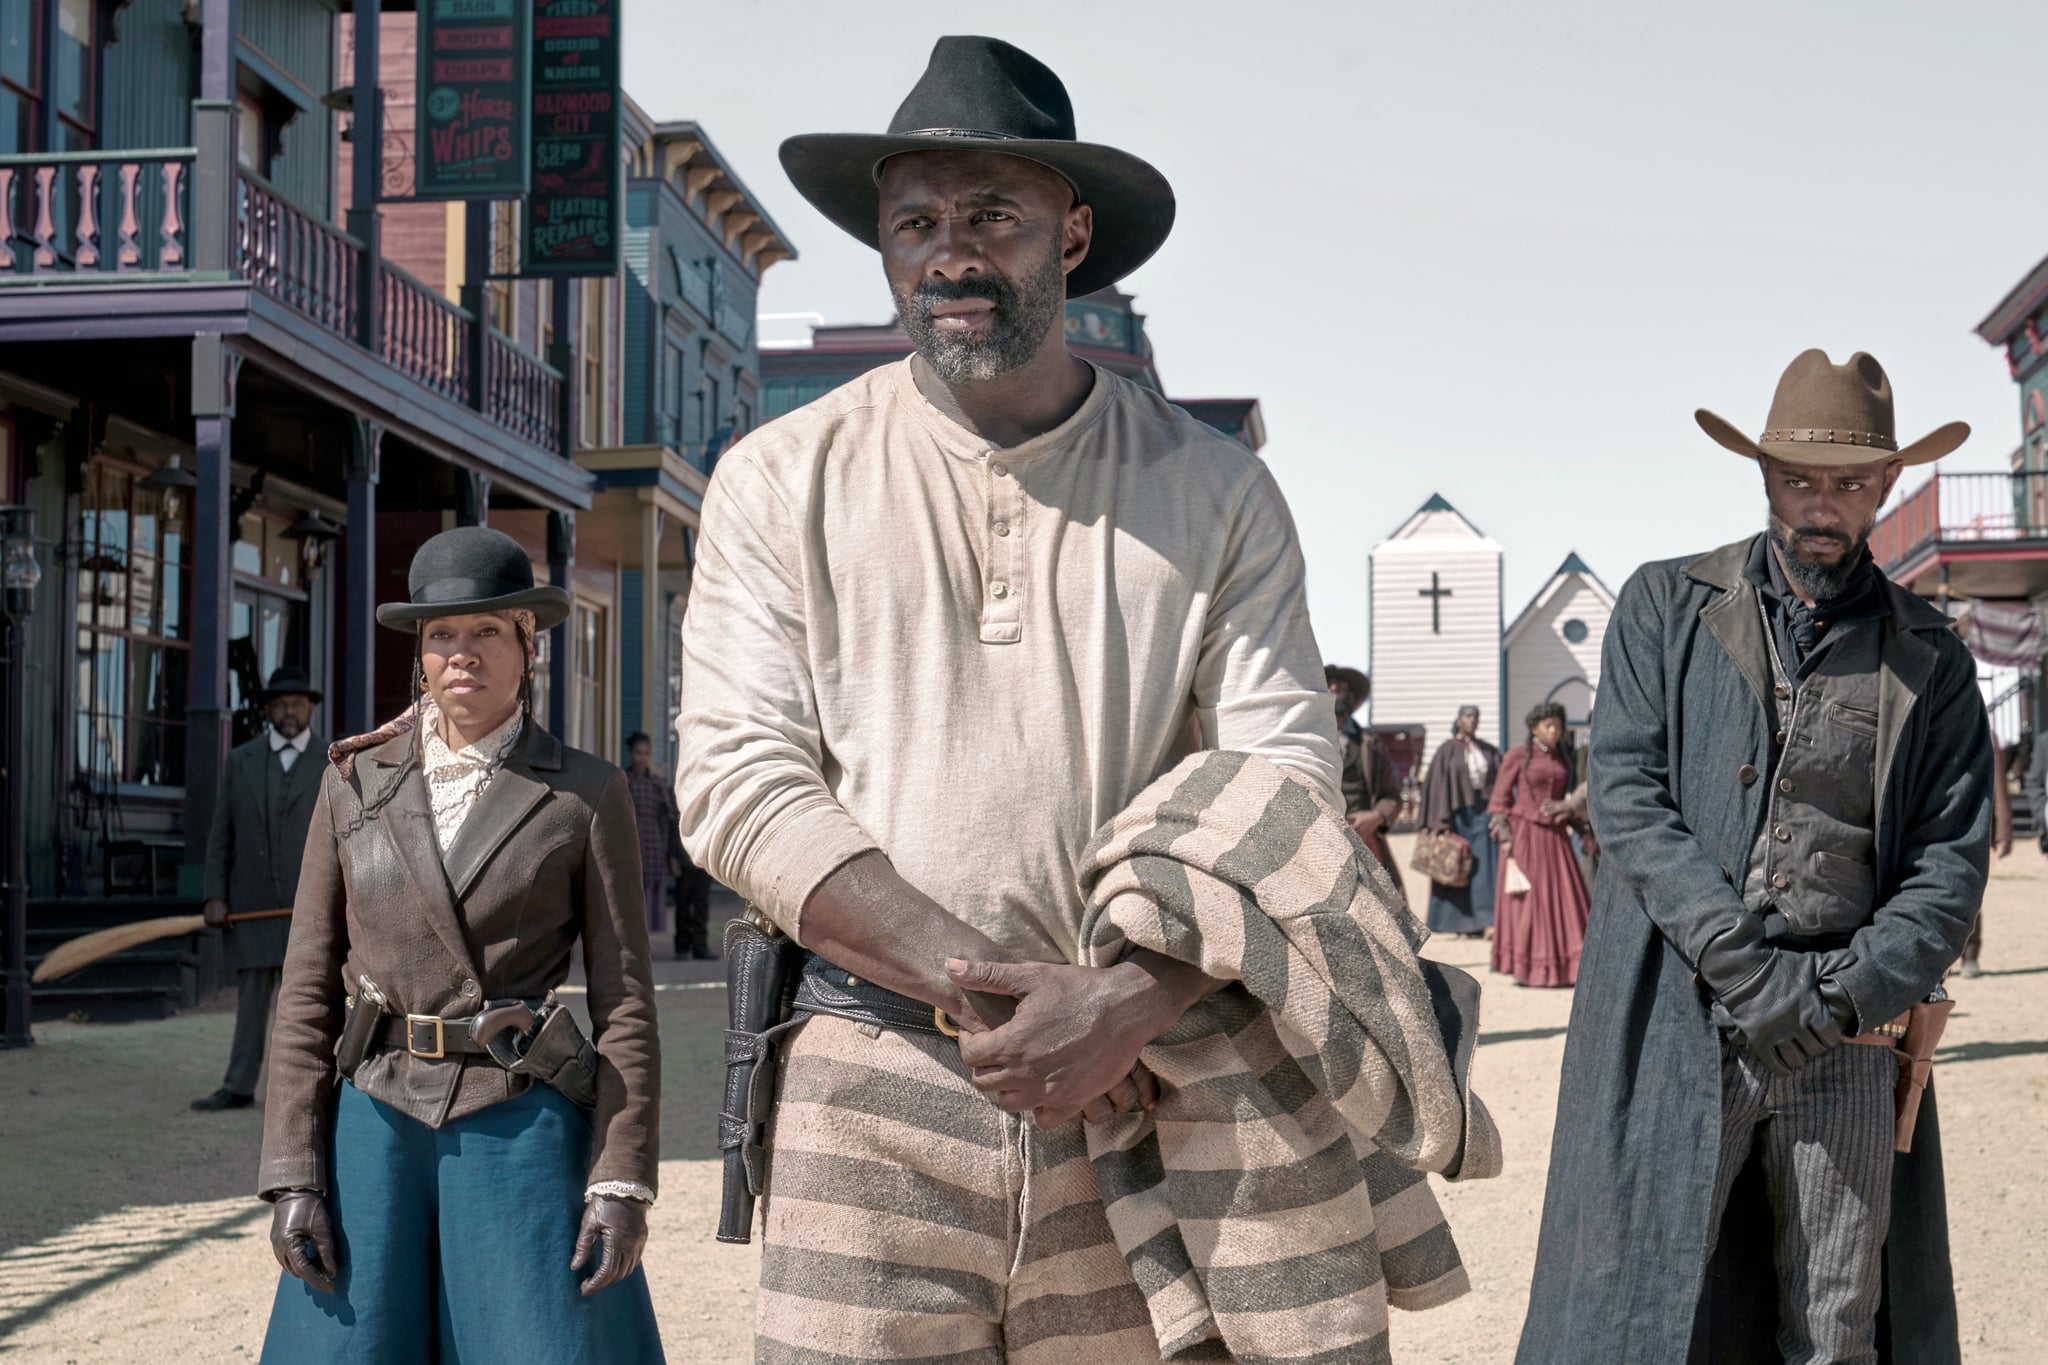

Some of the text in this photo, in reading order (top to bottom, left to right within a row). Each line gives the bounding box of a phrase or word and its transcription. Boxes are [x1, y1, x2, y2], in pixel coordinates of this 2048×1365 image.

[535, 92, 611, 114] REDWOOD
[553, 113, 590, 134] CITY
[534, 217, 609, 257] REPAIRS
